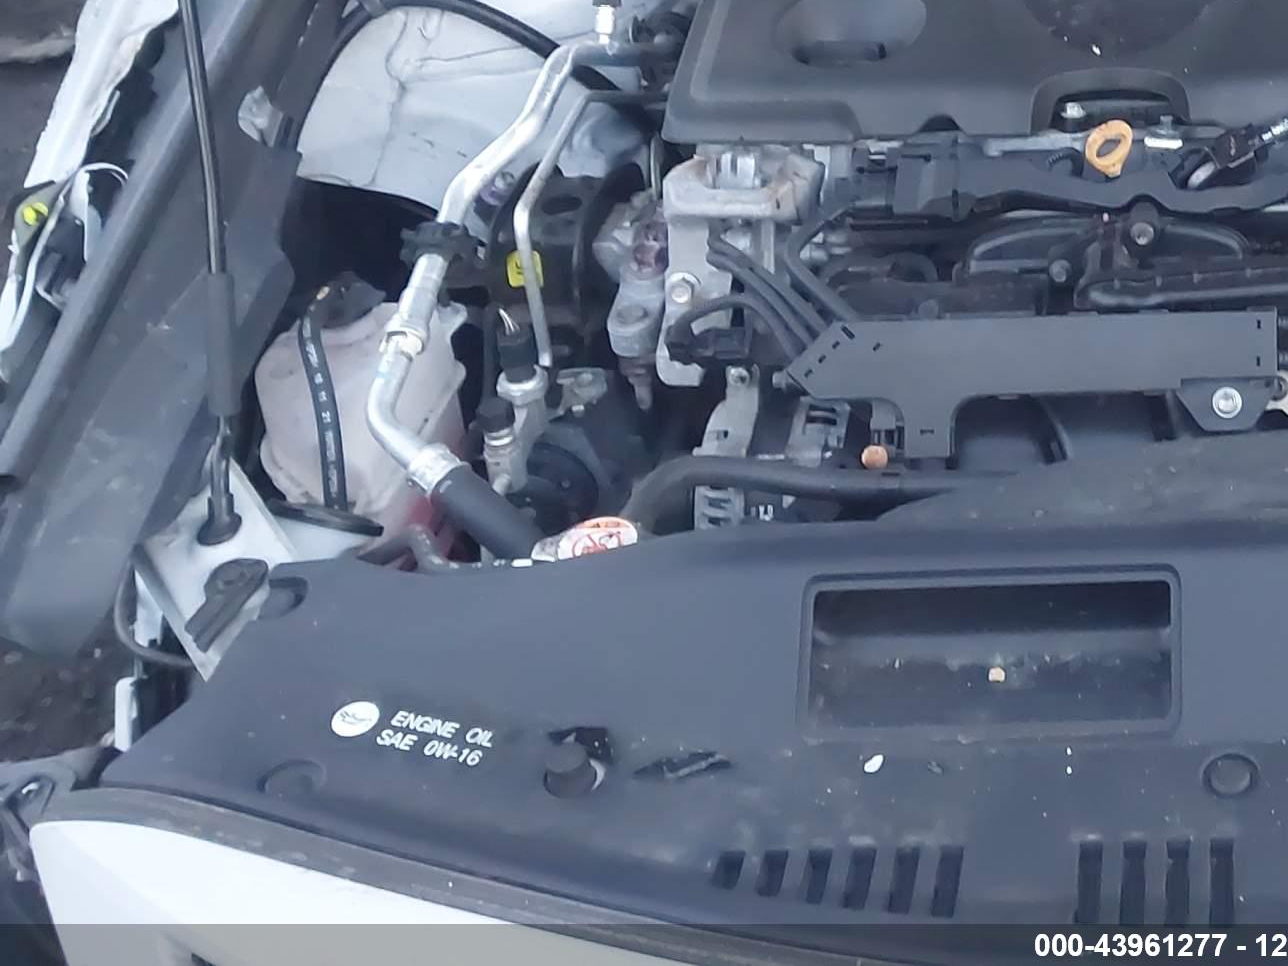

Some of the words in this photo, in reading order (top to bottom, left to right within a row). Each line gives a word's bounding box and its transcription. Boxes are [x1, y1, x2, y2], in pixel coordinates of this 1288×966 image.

[376, 728, 418, 751] SAE
[423, 739, 483, 766] 0W-16
[390, 710, 460, 738] ENGINE
[465, 727, 493, 748] OIL
